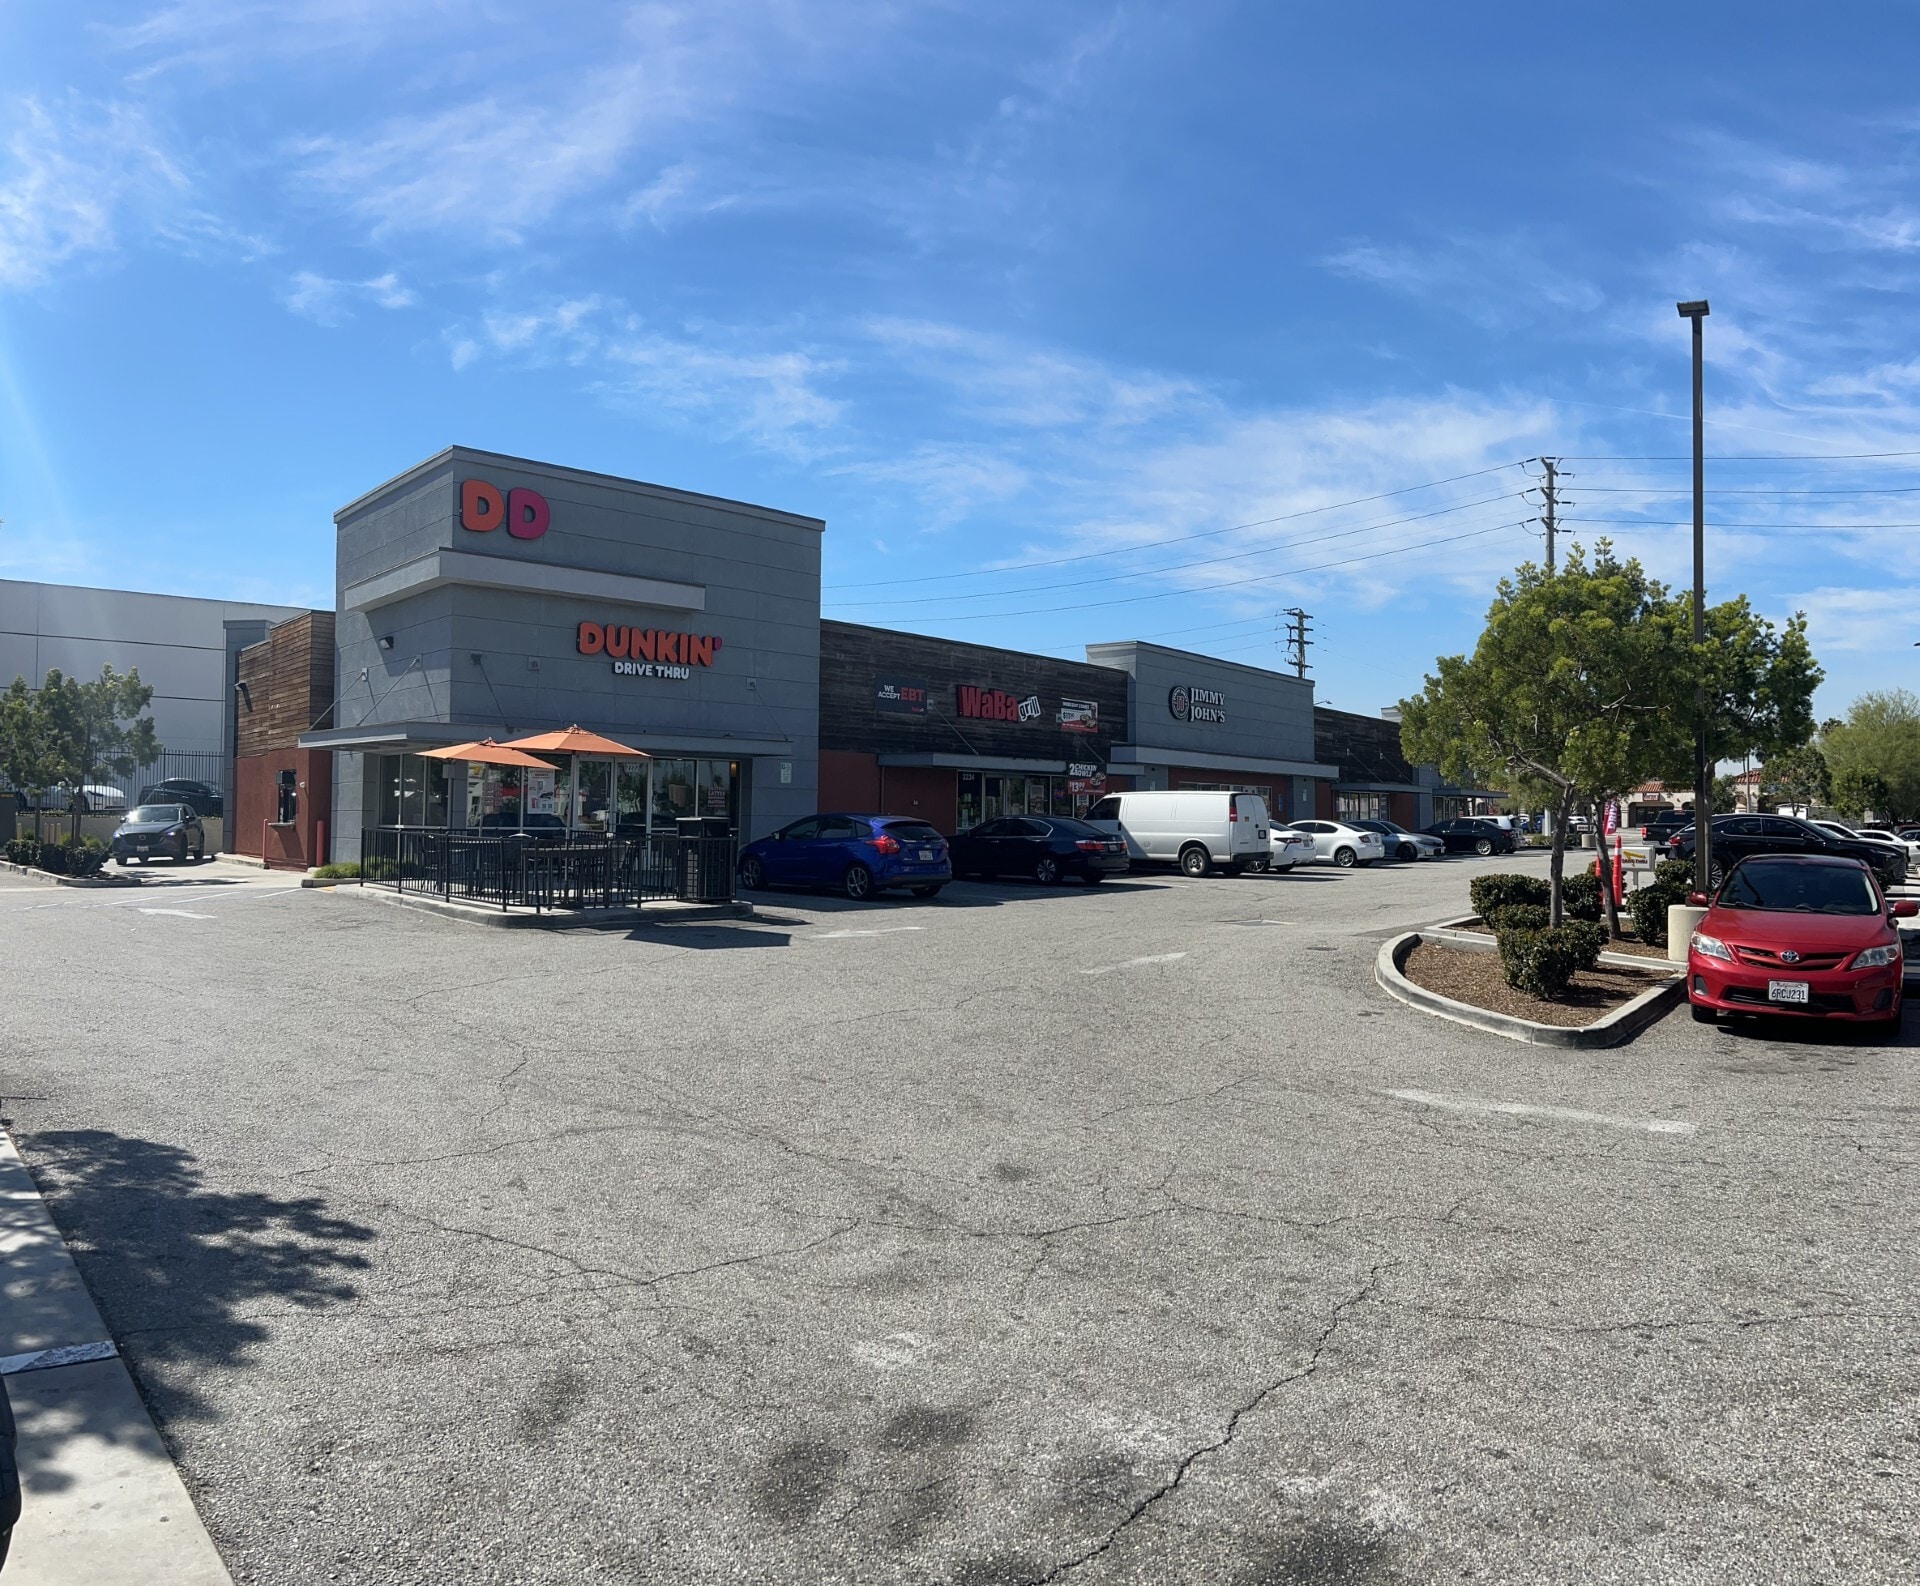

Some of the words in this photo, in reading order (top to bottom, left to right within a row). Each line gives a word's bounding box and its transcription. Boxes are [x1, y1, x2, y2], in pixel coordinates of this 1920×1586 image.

[460, 479, 551, 541] DD
[577, 621, 723, 667] DUNKIN'
[613, 662, 653, 677] DRIVE
[655, 665, 690, 680] THRU
[877, 691, 900, 700] ACCEPT
[900, 687, 925, 702] EBT
[883, 684, 895, 693] WE
[1190, 687, 1225, 705] JIMMY
[958, 684, 1018, 722] WaBa
[1018, 695, 1041, 722] grill
[1190, 706, 1226, 723] JOHN'S
[962, 773, 975, 781] 2234
[1771, 987, 1806, 1001] 6RCJ231
